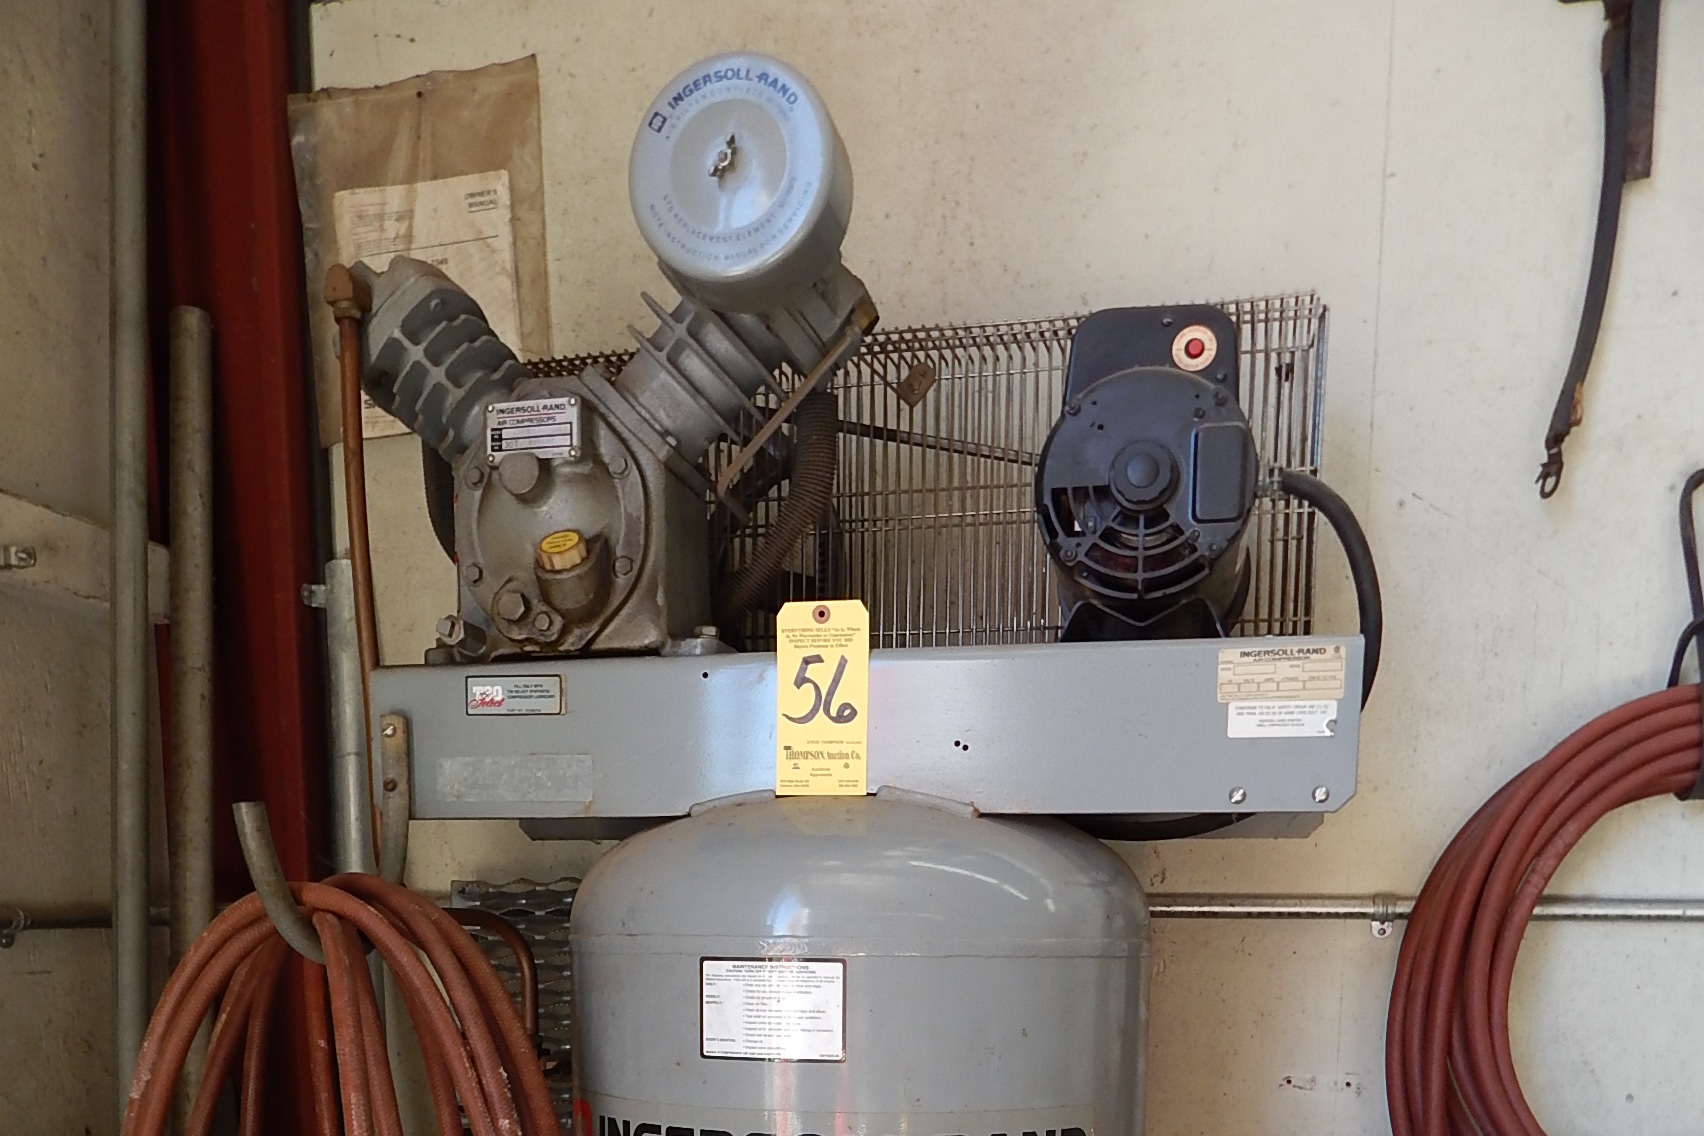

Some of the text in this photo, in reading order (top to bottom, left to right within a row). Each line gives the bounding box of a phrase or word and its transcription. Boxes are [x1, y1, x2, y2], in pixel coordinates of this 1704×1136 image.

[667, 67, 799, 110] INGERSOLL-RAND
[496, 403, 566, 415] INGERSOLL-RAND
[1239, 647, 1327, 658] INGERSOLL-RAND
[781, 654, 858, 724] 56
[783, 746, 825, 760] THOMPSON
[827, 750, 850, 760] Auction
